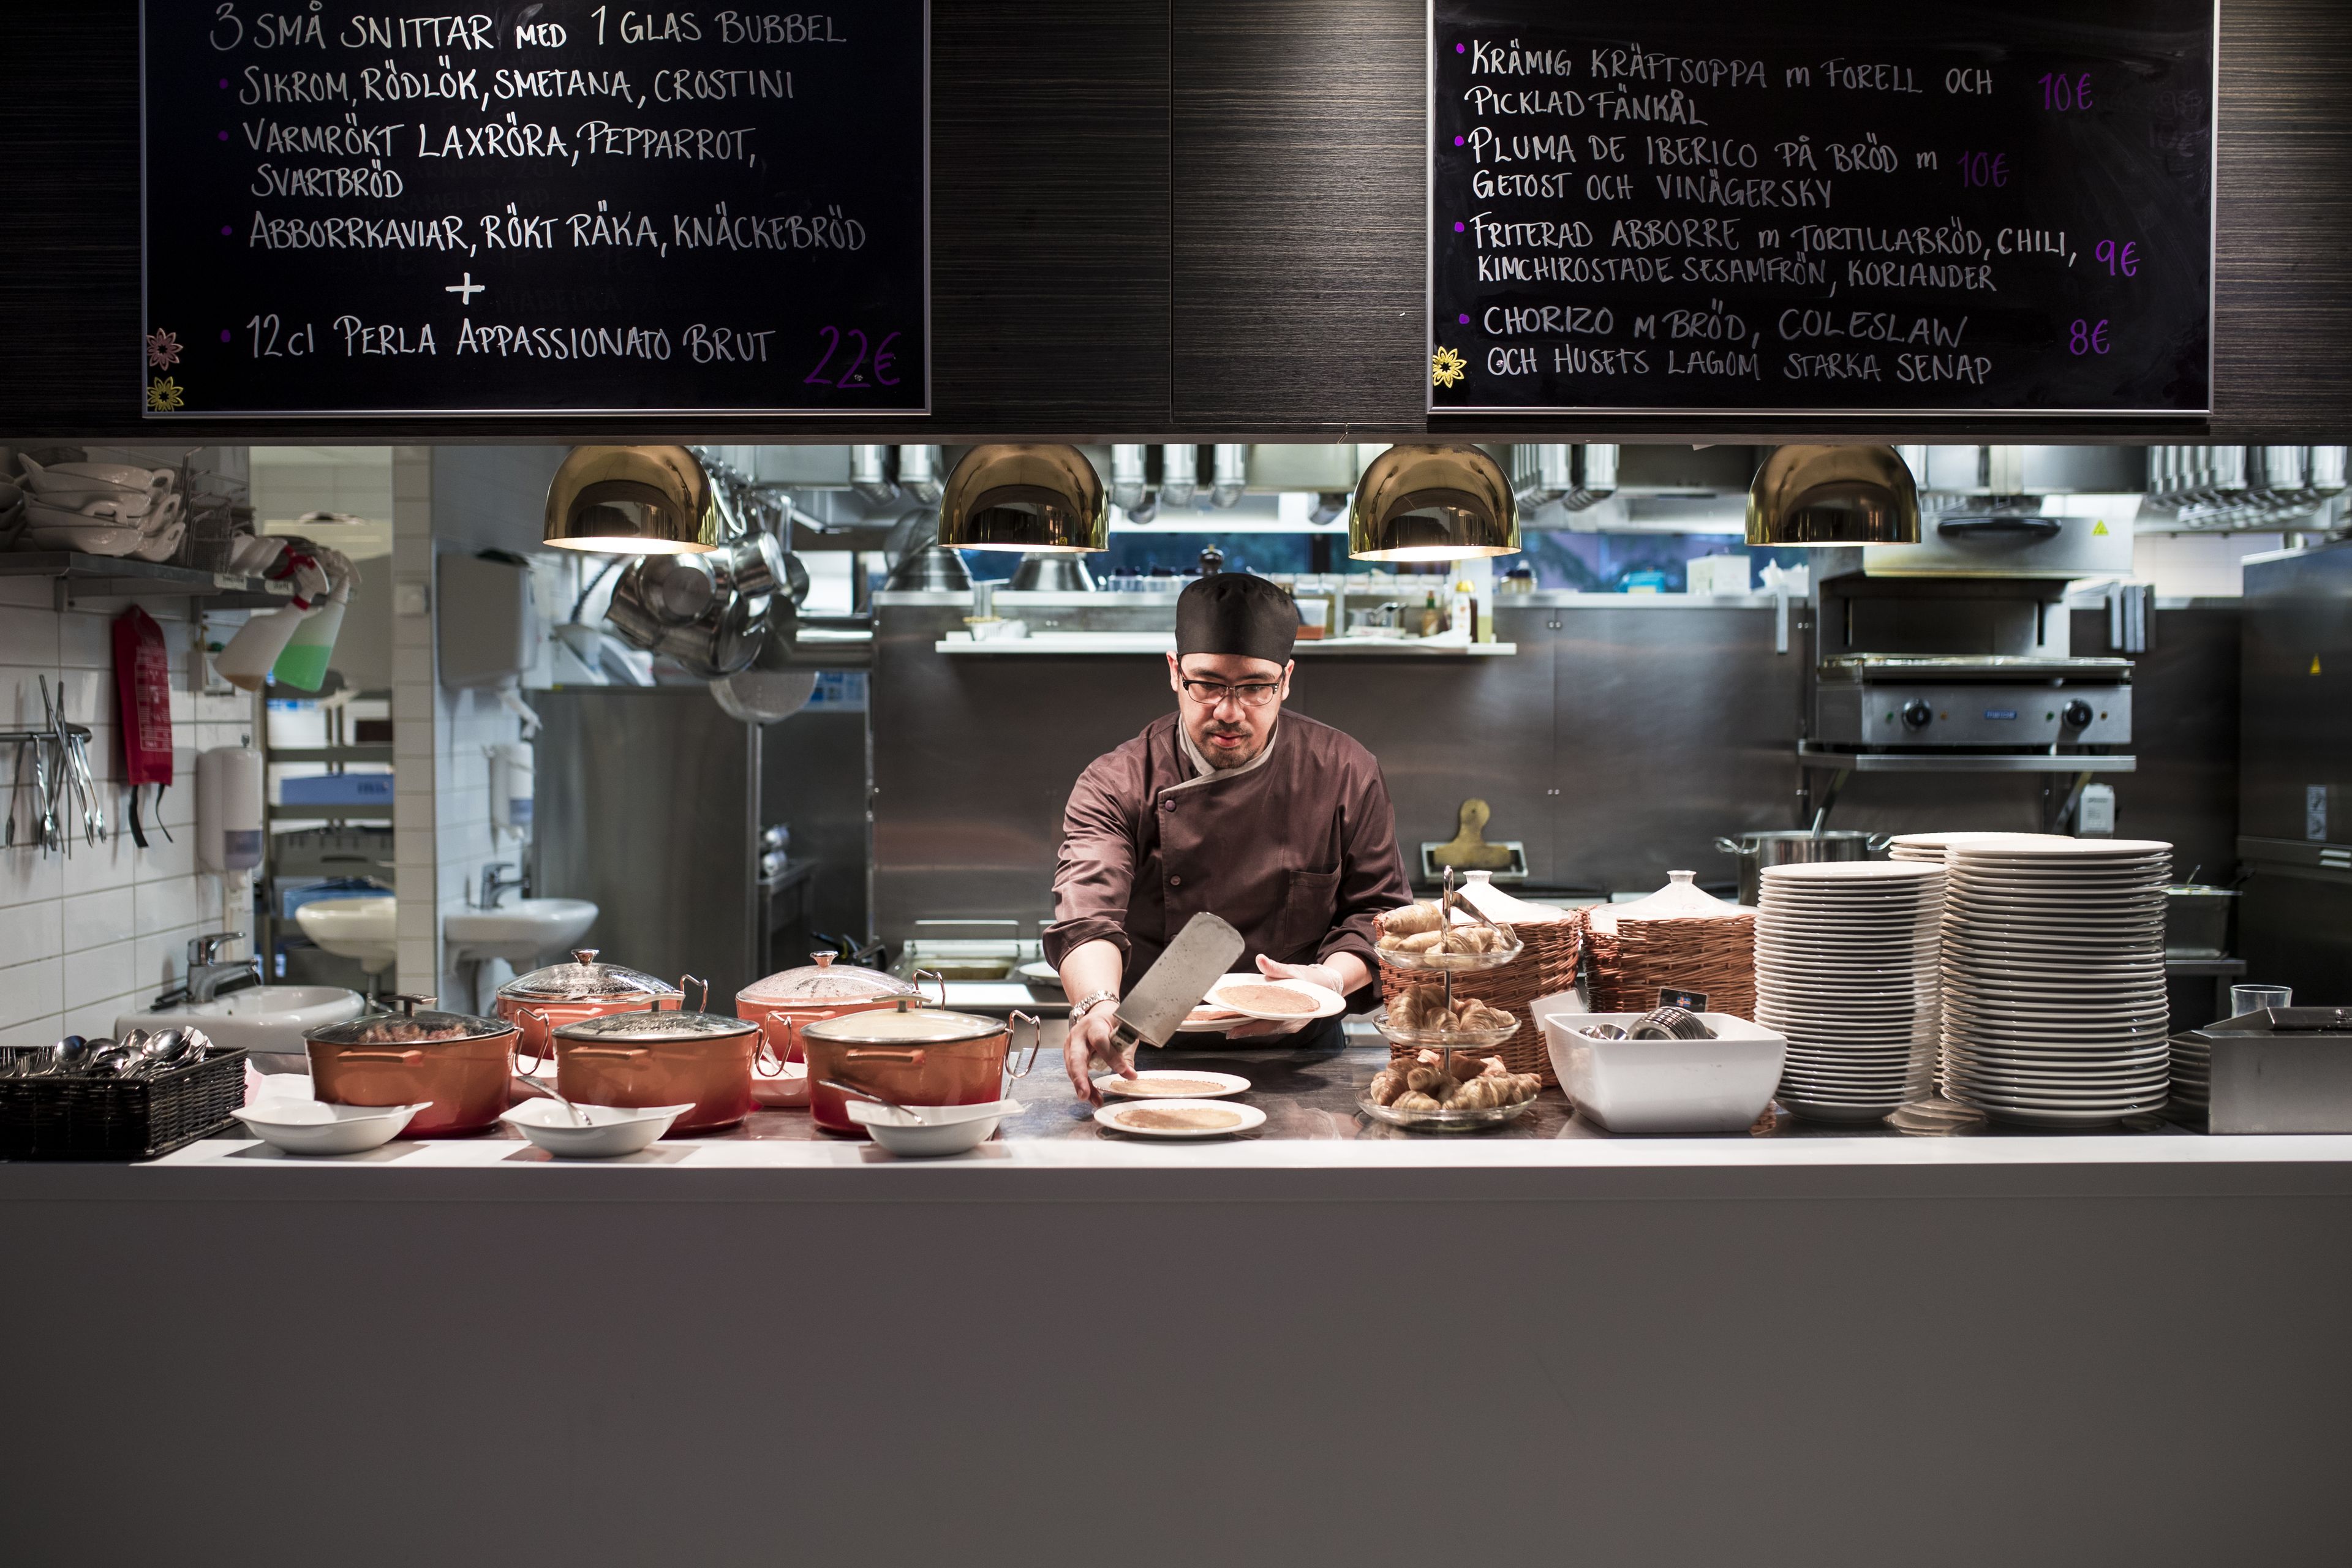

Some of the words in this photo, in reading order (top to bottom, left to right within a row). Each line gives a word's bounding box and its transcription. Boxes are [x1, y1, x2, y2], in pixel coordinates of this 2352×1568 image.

[210, 2, 243, 51] 3
[254, 0, 326, 49] SMÅ
[341, 14, 494, 50] SNITTAR
[516, 24, 567, 49] MED
[591, 6, 606, 45] 1
[620, 11, 701, 43] GLAS
[714, 10, 846, 43] BUBBEL
[239, 66, 357, 107] SIKROM,
[361, 55, 489, 111] RÖDLÖK,
[494, 69, 646, 108] SMETANA,
[654, 69, 793, 102] CROSTINI
[1471, 39, 1570, 75] KRÄMIG
[1591, 43, 1766, 88] KRÄFTSOPPA
[1820, 58, 1923, 93] FORELL
[1945, 68, 1992, 94] OCH
[2038, 73, 2093, 111] 10€
[1464, 85, 1585, 116] PICKLAD
[1588, 83, 1708, 126] FÄNKÅL
[243, 113, 404, 157] VARMRÖKT
[419, 111, 579, 167] LAXRÖRA,
[576, 121, 755, 167] PEPPARROT,
[1468, 126, 1576, 164] PLUMA
[1588, 135, 1626, 162] DE
[1647, 136, 1757, 168] IBERICO
[1774, 135, 1817, 171] PÅ
[1825, 132, 1898, 173] BRÖD
[1958, 151, 2009, 187] 10€
[252, 159, 403, 198] SVARTBRÖD
[1472, 170, 1572, 198] GETOST
[1586, 174, 1633, 200] OCH
[1656, 169, 1831, 208] VINÄGERSKY
[251, 211, 477, 257] ABBORRKAVIAR,
[480, 202, 558, 249] RÖKT
[566, 200, 666, 257] RÄKA,
[674, 201, 865, 251] KNÄCKEBRÖD
[1469, 211, 1593, 249] FRITERAD
[1611, 219, 1740, 250] ABBORRE
[1790, 216, 1991, 260] TORTILLABRÖD,
[1997, 228, 2077, 267] CHILI,
[2095, 239, 2139, 277] 9€
[1478, 255, 1673, 282] KIMCHIROSTADE
[1849, 259, 1997, 292] KORIANDER
[333, 315, 436, 356] PERLA
[457, 318, 670, 360] APPASSIONATO
[682, 323, 775, 363] BRUT
[804, 325, 900, 389] 22€
[1484, 306, 1613, 334] CHORIZO
[1779, 309, 1968, 348] COLESLAW
[2070, 319, 2110, 355] 8€
[1488, 347, 1537, 375] OCH
[1554, 344, 1649, 375] HUSETS
[1668, 349, 1760, 380] LAGOM
[1784, 353, 1881, 382] STARKA
[1897, 353, 1991, 384] SENAP
